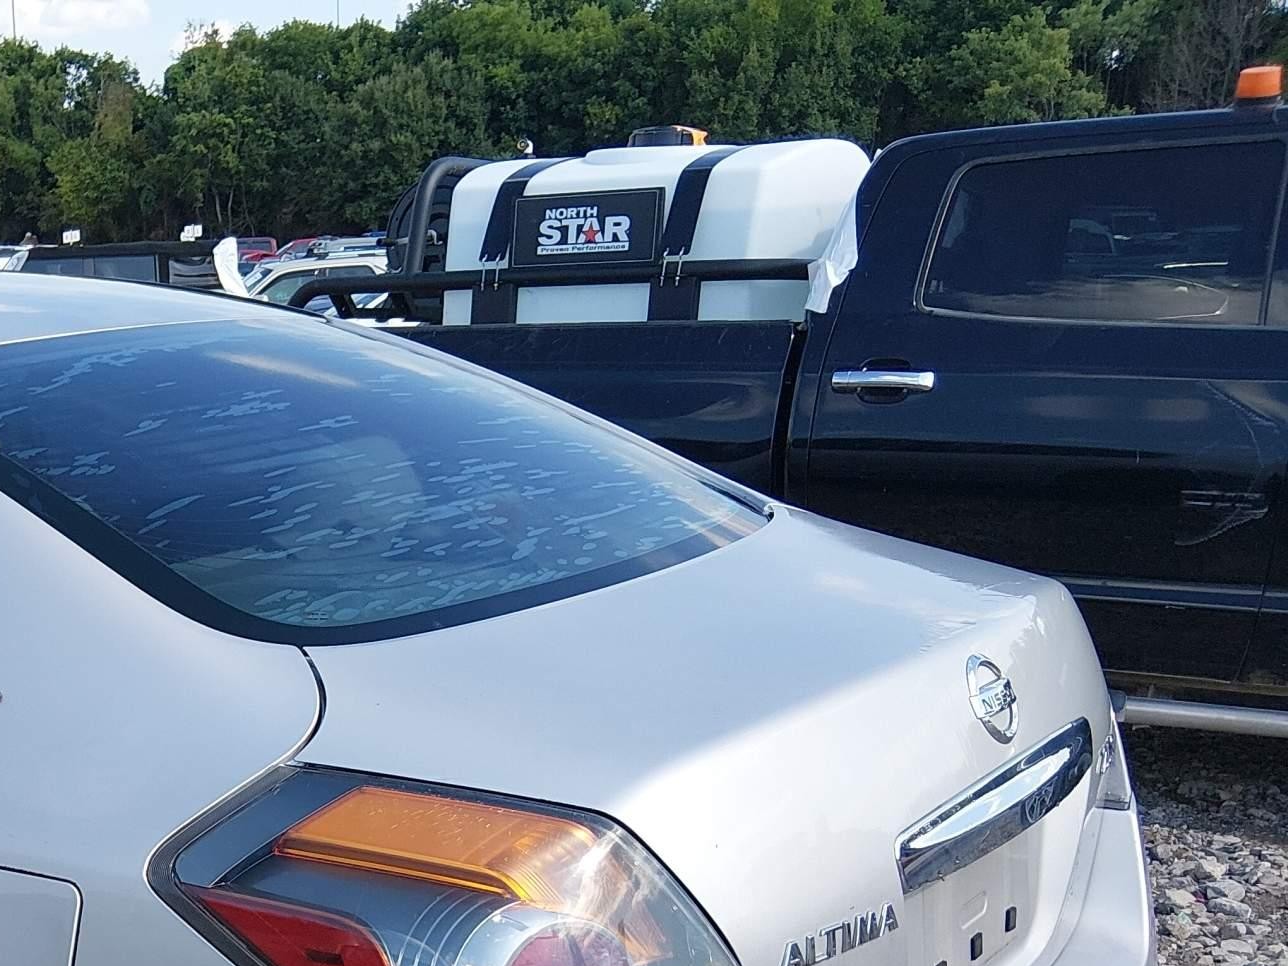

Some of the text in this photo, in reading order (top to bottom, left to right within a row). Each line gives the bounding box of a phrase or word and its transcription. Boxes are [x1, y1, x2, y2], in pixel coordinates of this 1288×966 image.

[545, 206, 598, 219] NORTH
[537, 215, 631, 245] STAR
[540, 243, 626, 254] Proven Performance
